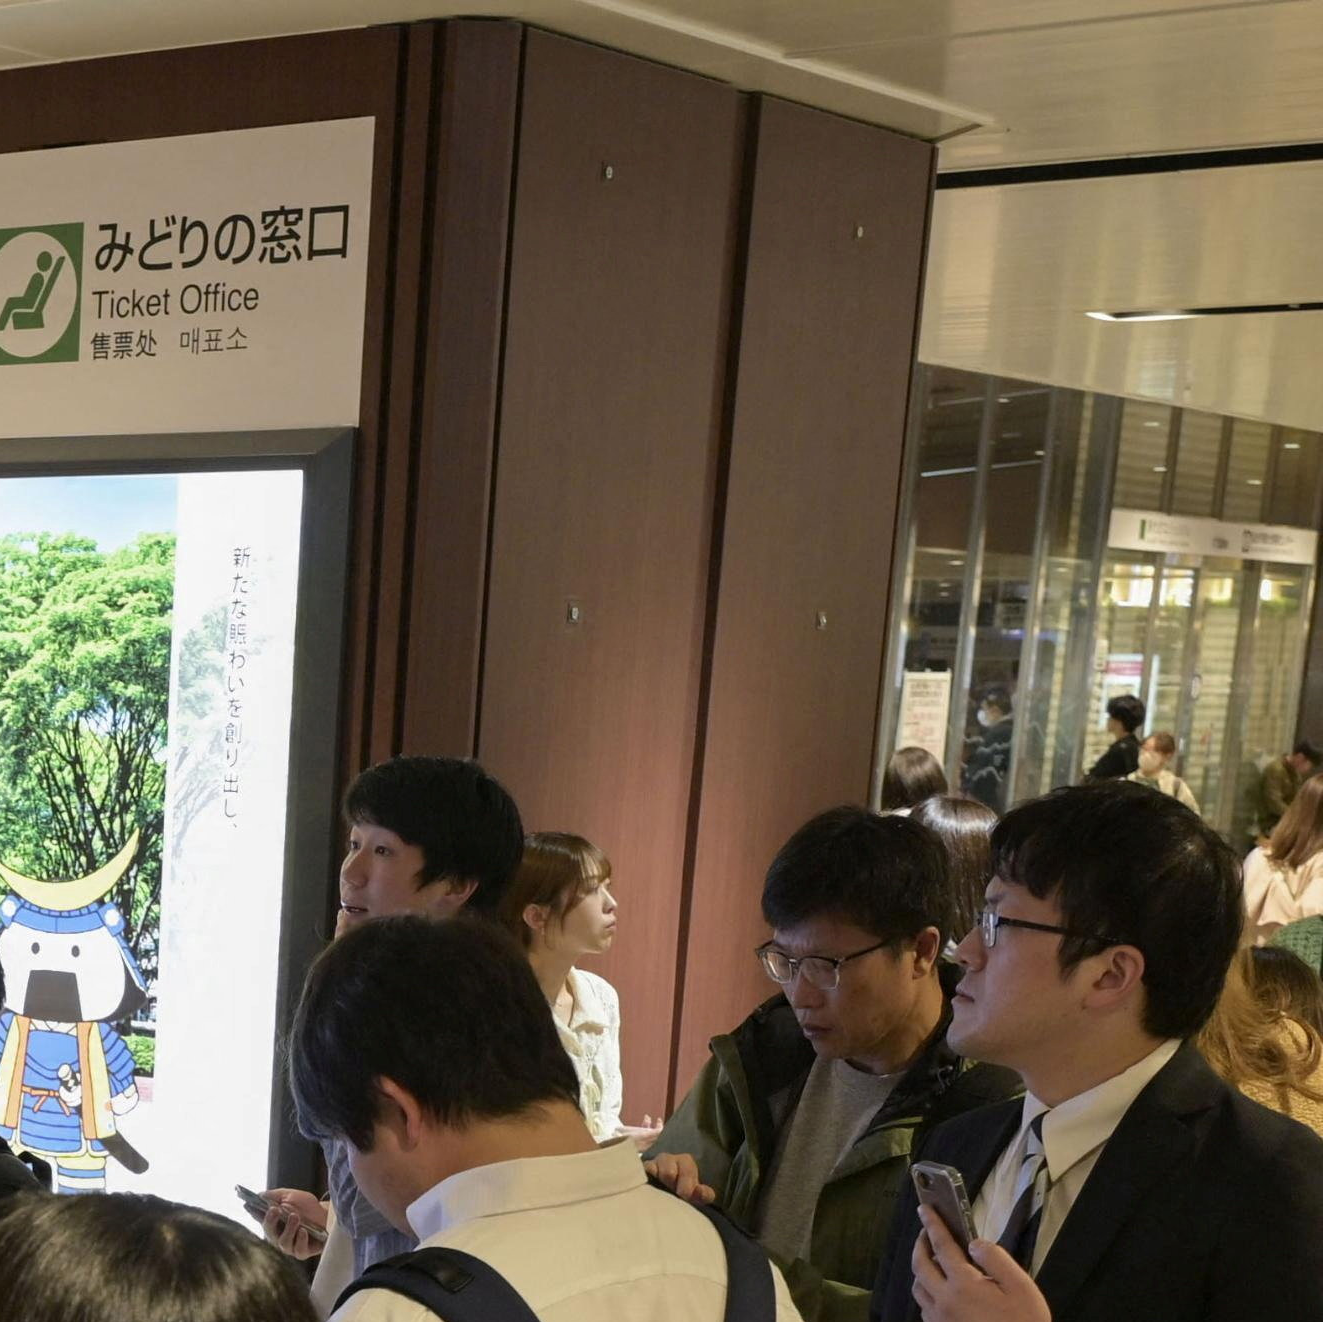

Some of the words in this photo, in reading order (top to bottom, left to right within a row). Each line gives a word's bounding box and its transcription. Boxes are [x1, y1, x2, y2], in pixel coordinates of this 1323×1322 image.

[93, 204, 350, 273] みどりの窓口
[91, 286, 170, 319] Ticket
[179, 282, 260, 314] Office
[90, 329, 157, 361] 售票处
[179, 327, 248, 355] 매표소
